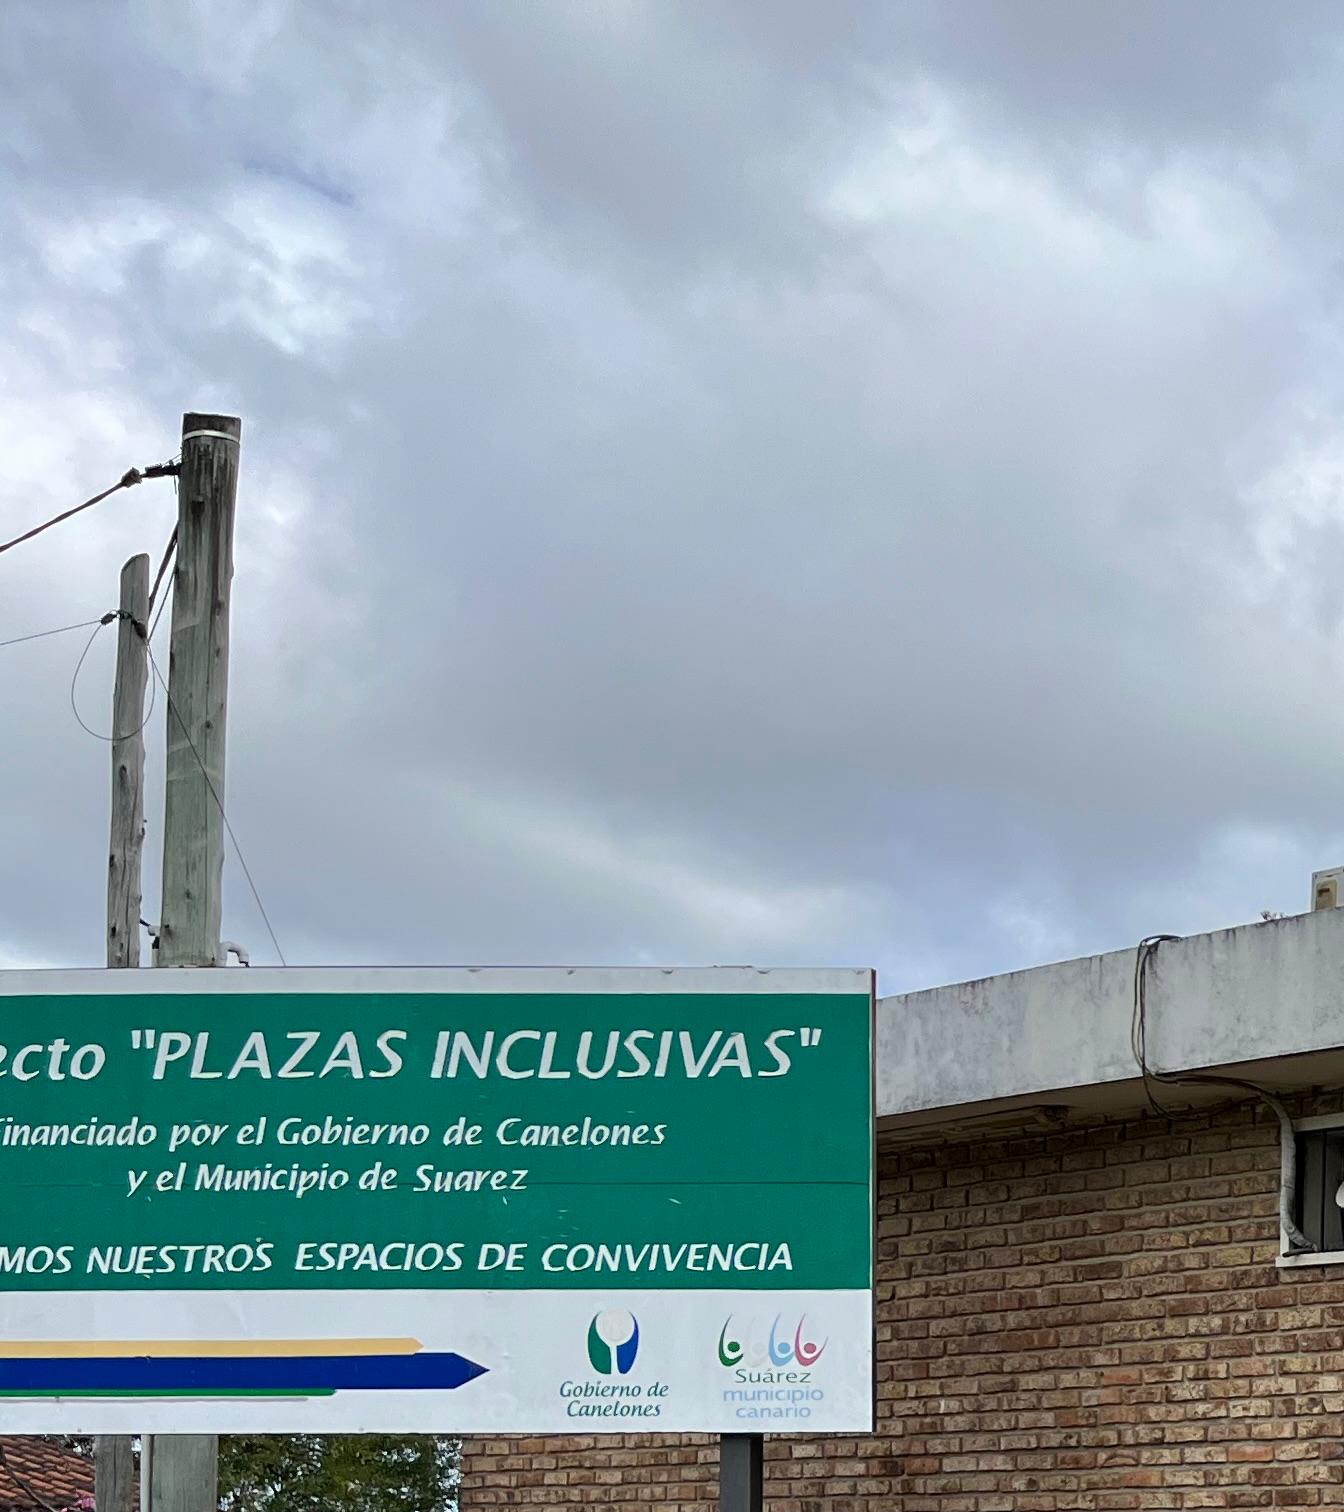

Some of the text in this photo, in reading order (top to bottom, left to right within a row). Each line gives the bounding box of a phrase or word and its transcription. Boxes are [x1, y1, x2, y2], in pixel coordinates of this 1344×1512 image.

[0, 1027, 822, 1081] cto "PLAZAS INCLUSIVAS"
[0, 1115, 667, 1153] inanciado por el Gobierno de Canelones
[127, 1161, 529, 1199] y el Municipio de Suarez
[0, 1242, 793, 1274] MOS NUESTROS ESPACIOS DE CONVIVENCIA
[735, 1368, 812, 1384] Suárez
[559, 1380, 670, 1398] Gobierno de
[722, 1388, 825, 1405] municipio
[566, 1399, 662, 1418] Canelones
[735, 1406, 812, 1419] canario
